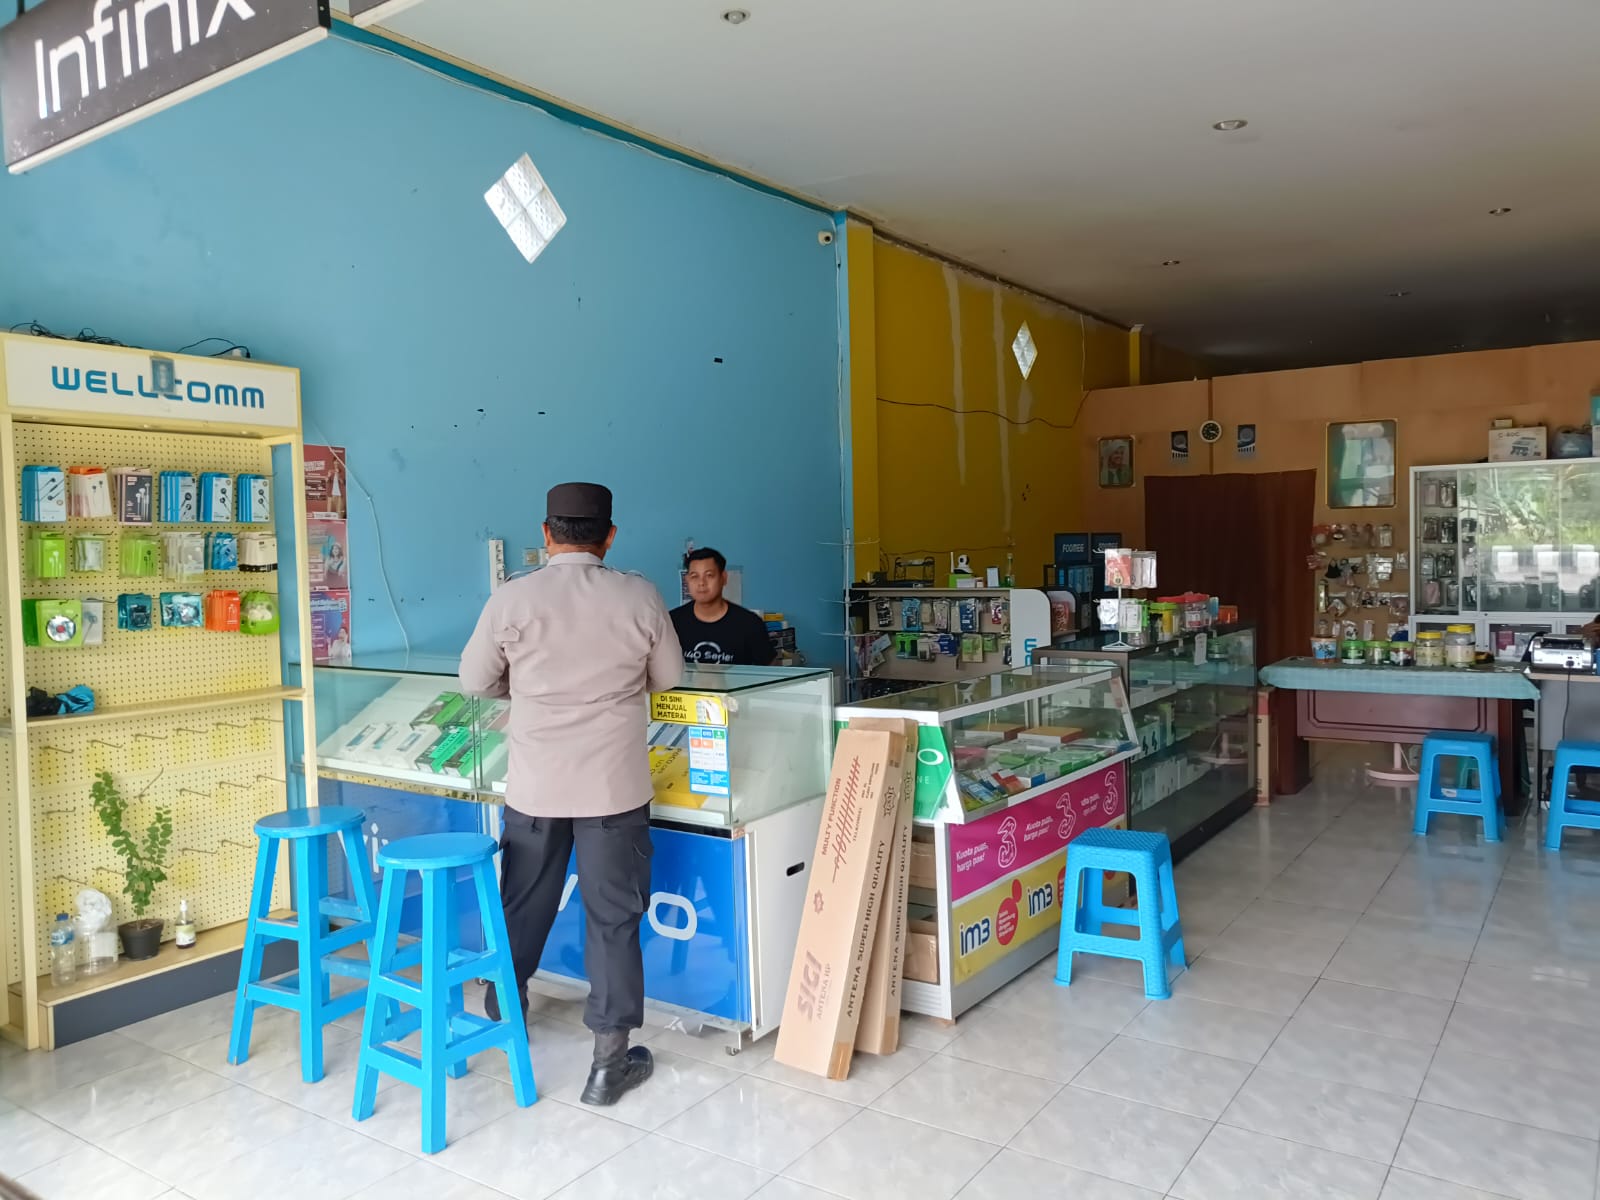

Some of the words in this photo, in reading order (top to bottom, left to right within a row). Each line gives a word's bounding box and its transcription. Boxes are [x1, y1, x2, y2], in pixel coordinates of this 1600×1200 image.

[656, 703, 687, 711] MENJUAL
[657, 711, 687, 720] MATERAI
[669, 695, 683, 703] SINI
[828, 777, 842, 821] FUNCTION
[1026, 820, 1041, 832] Kuota
[900, 824, 908, 872] QUALITY
[956, 847, 974, 861] Kuota
[1027, 883, 1053, 917] im3
[846, 965, 861, 1018] ANTENA
[857, 922, 870, 962] SUPER
[864, 892, 876, 922] HIGH
[871, 840, 886, 890] QUALITY
[895, 905, 903, 944] SUPER
[960, 917, 991, 956] im3
[891, 946, 900, 997] ANTENA
